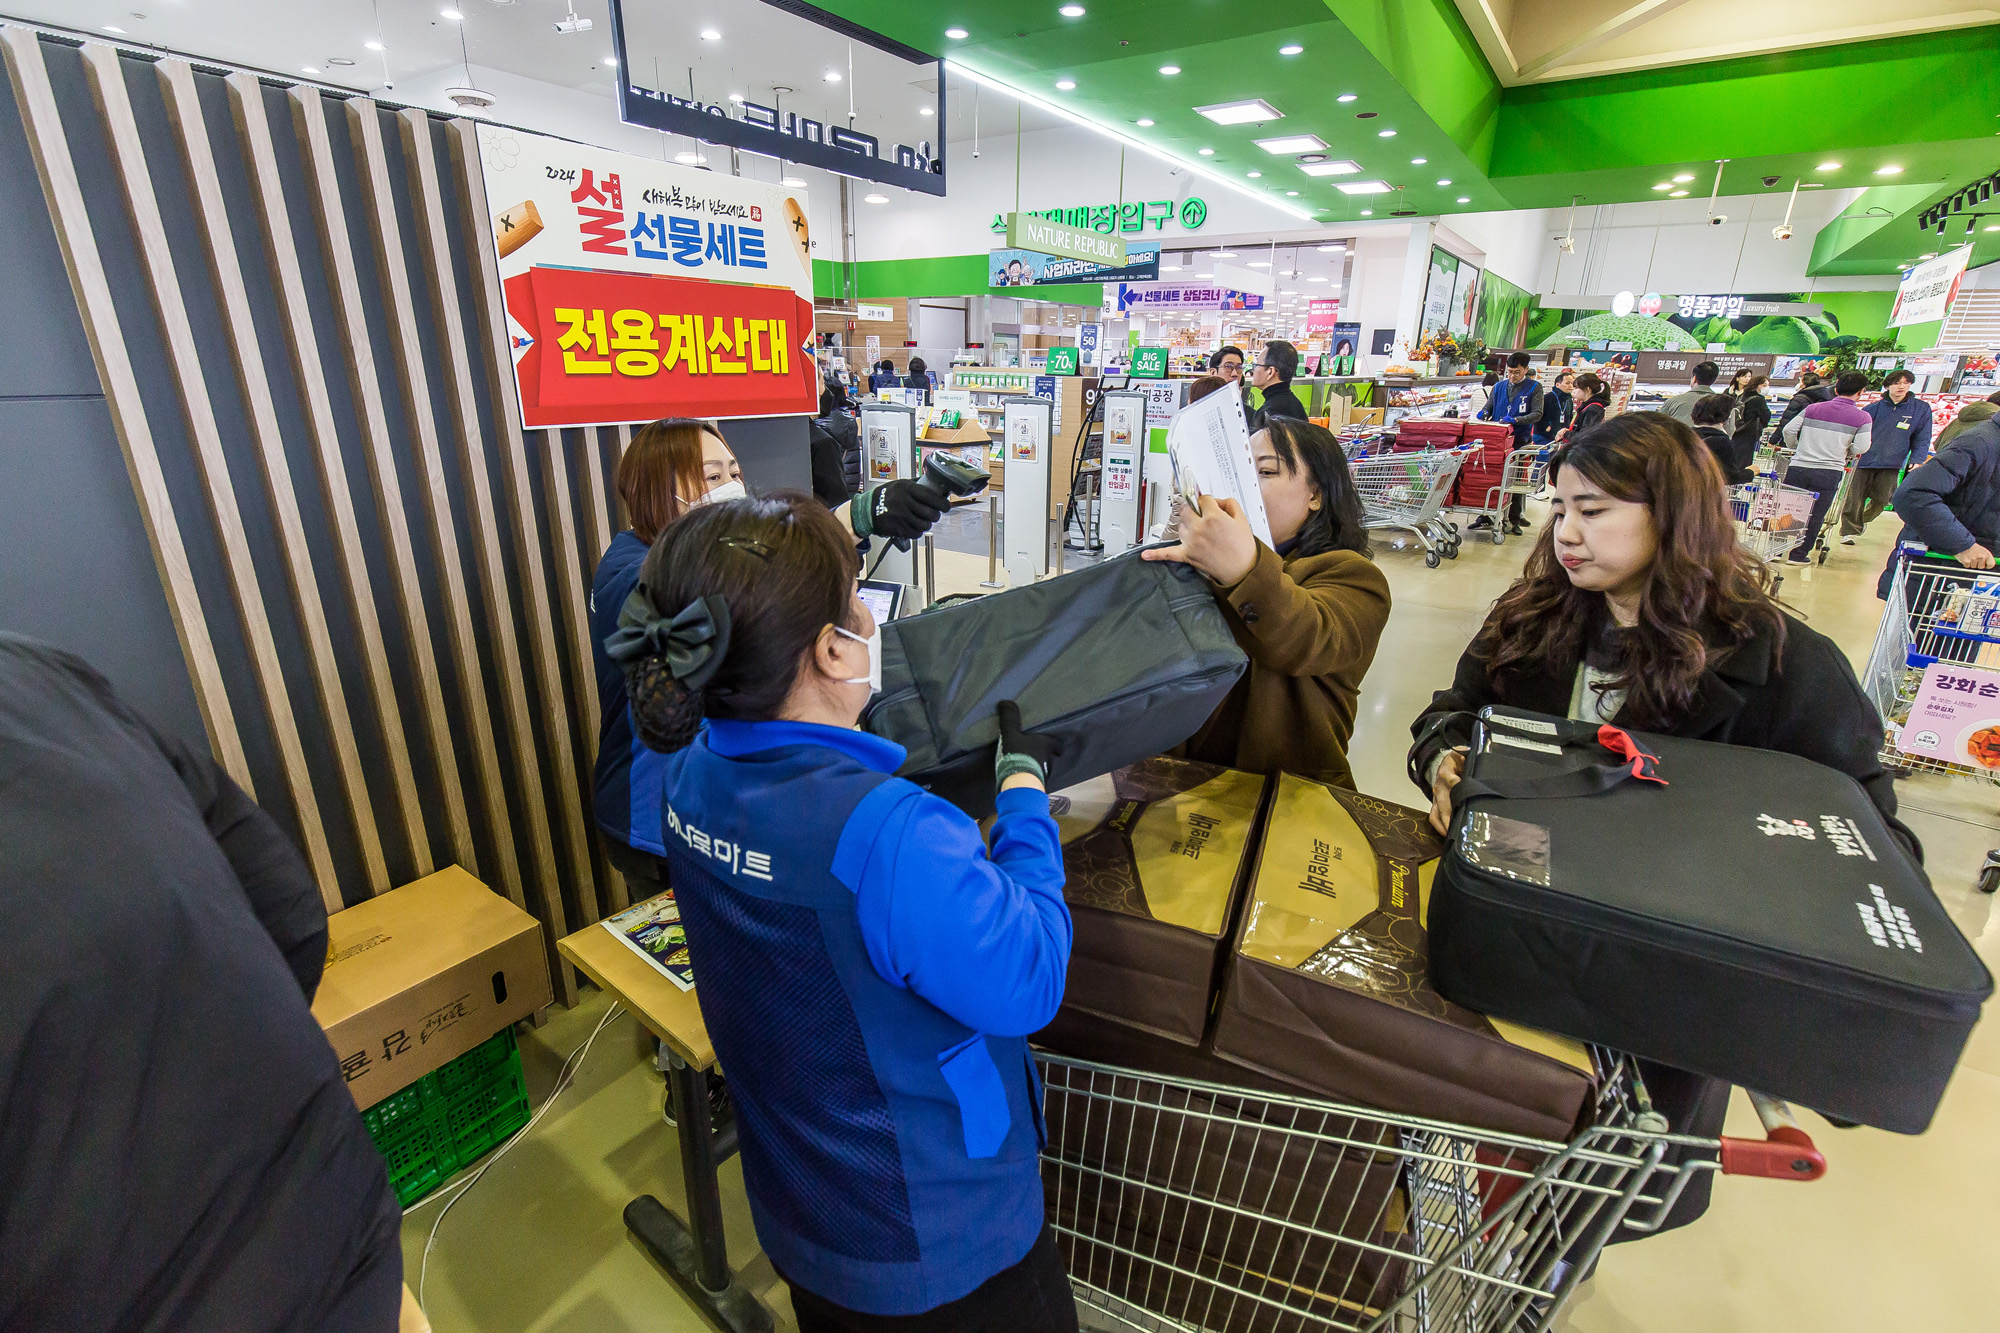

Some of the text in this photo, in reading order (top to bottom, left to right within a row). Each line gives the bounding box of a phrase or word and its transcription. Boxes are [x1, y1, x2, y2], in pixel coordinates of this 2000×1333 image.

[545, 166, 576, 184] 2024
[570, 167, 629, 256] 설
[684, 195, 706, 212] 많이
[709, 199, 749, 218] 받으세요
[630, 210, 768, 270] 선물세트
[1027, 222, 1119, 260] NATURE REPUBLIC
[1144, 289, 1220, 302] 선물세트 상담코너
[1678, 295, 1744, 319] 명품과일
[1743, 304, 1780, 314] Luxury fruit
[554, 307, 789, 376] 전용계산대
[1083, 336, 1095, 346] 50
[1136, 361, 1161, 371] SALE
[1142, 352, 1158, 361] BIG
[1657, 359, 1687, 371] 명품과일
[1108, 481, 1131, 490] 반입금지
[1936, 674, 1976, 694] 강화
[1389, 859, 1409, 908] Premium
